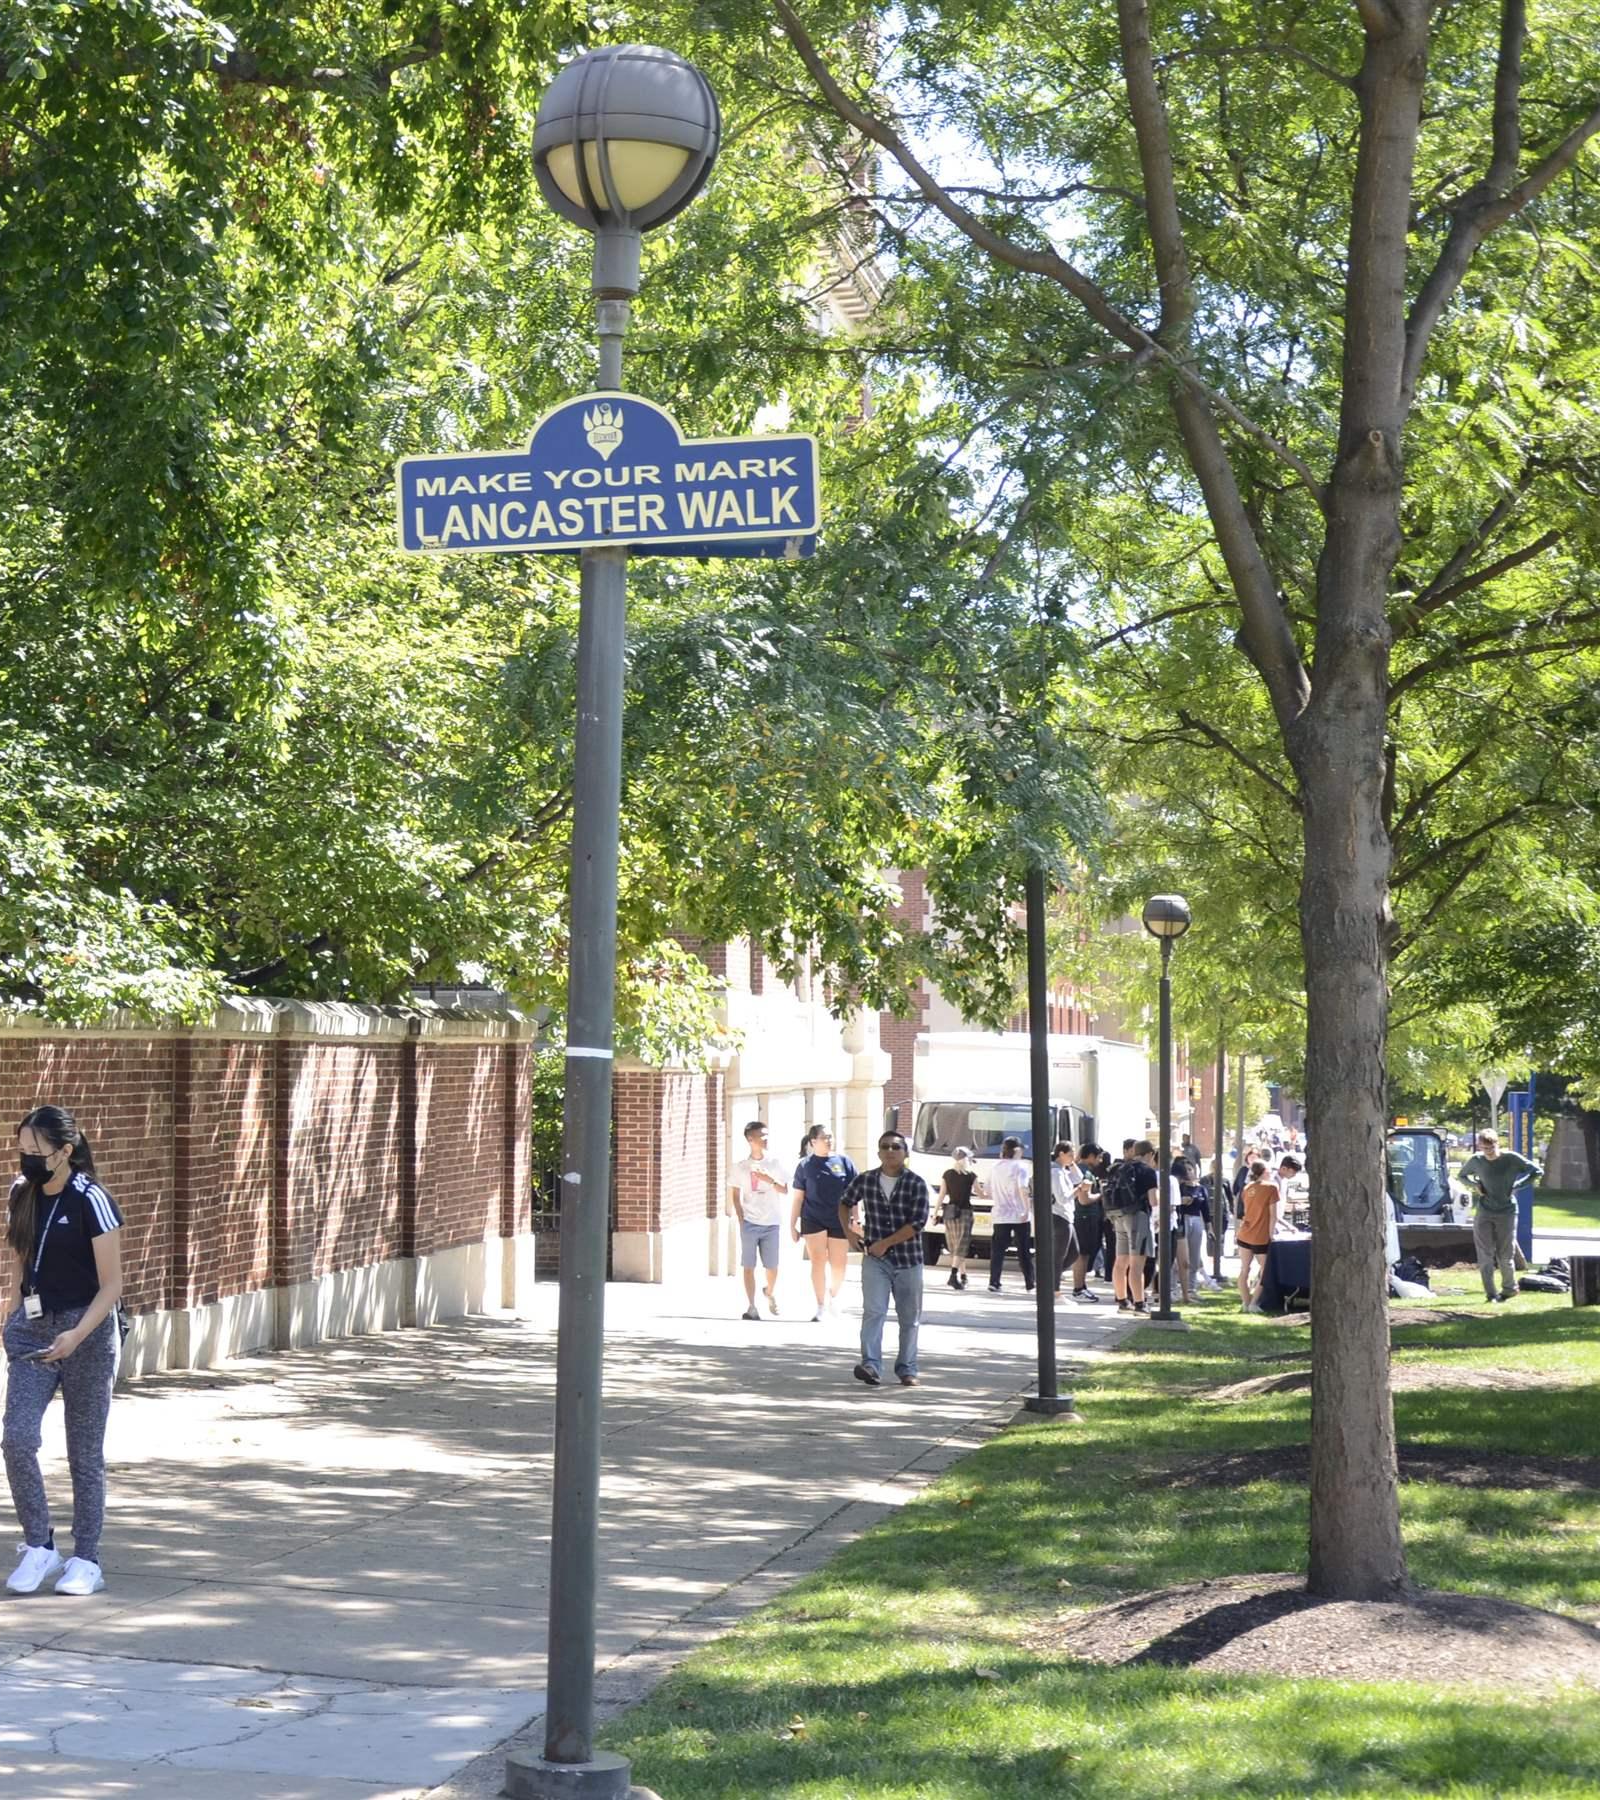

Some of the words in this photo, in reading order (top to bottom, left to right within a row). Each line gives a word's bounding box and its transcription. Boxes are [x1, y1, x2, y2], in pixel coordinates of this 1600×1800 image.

[415, 472, 532, 496] MAKE
[544, 465, 661, 489] YOUR
[674, 457, 797, 482] MARK
[415, 494, 667, 543] LANCASTER
[677, 486, 801, 528] WALK
